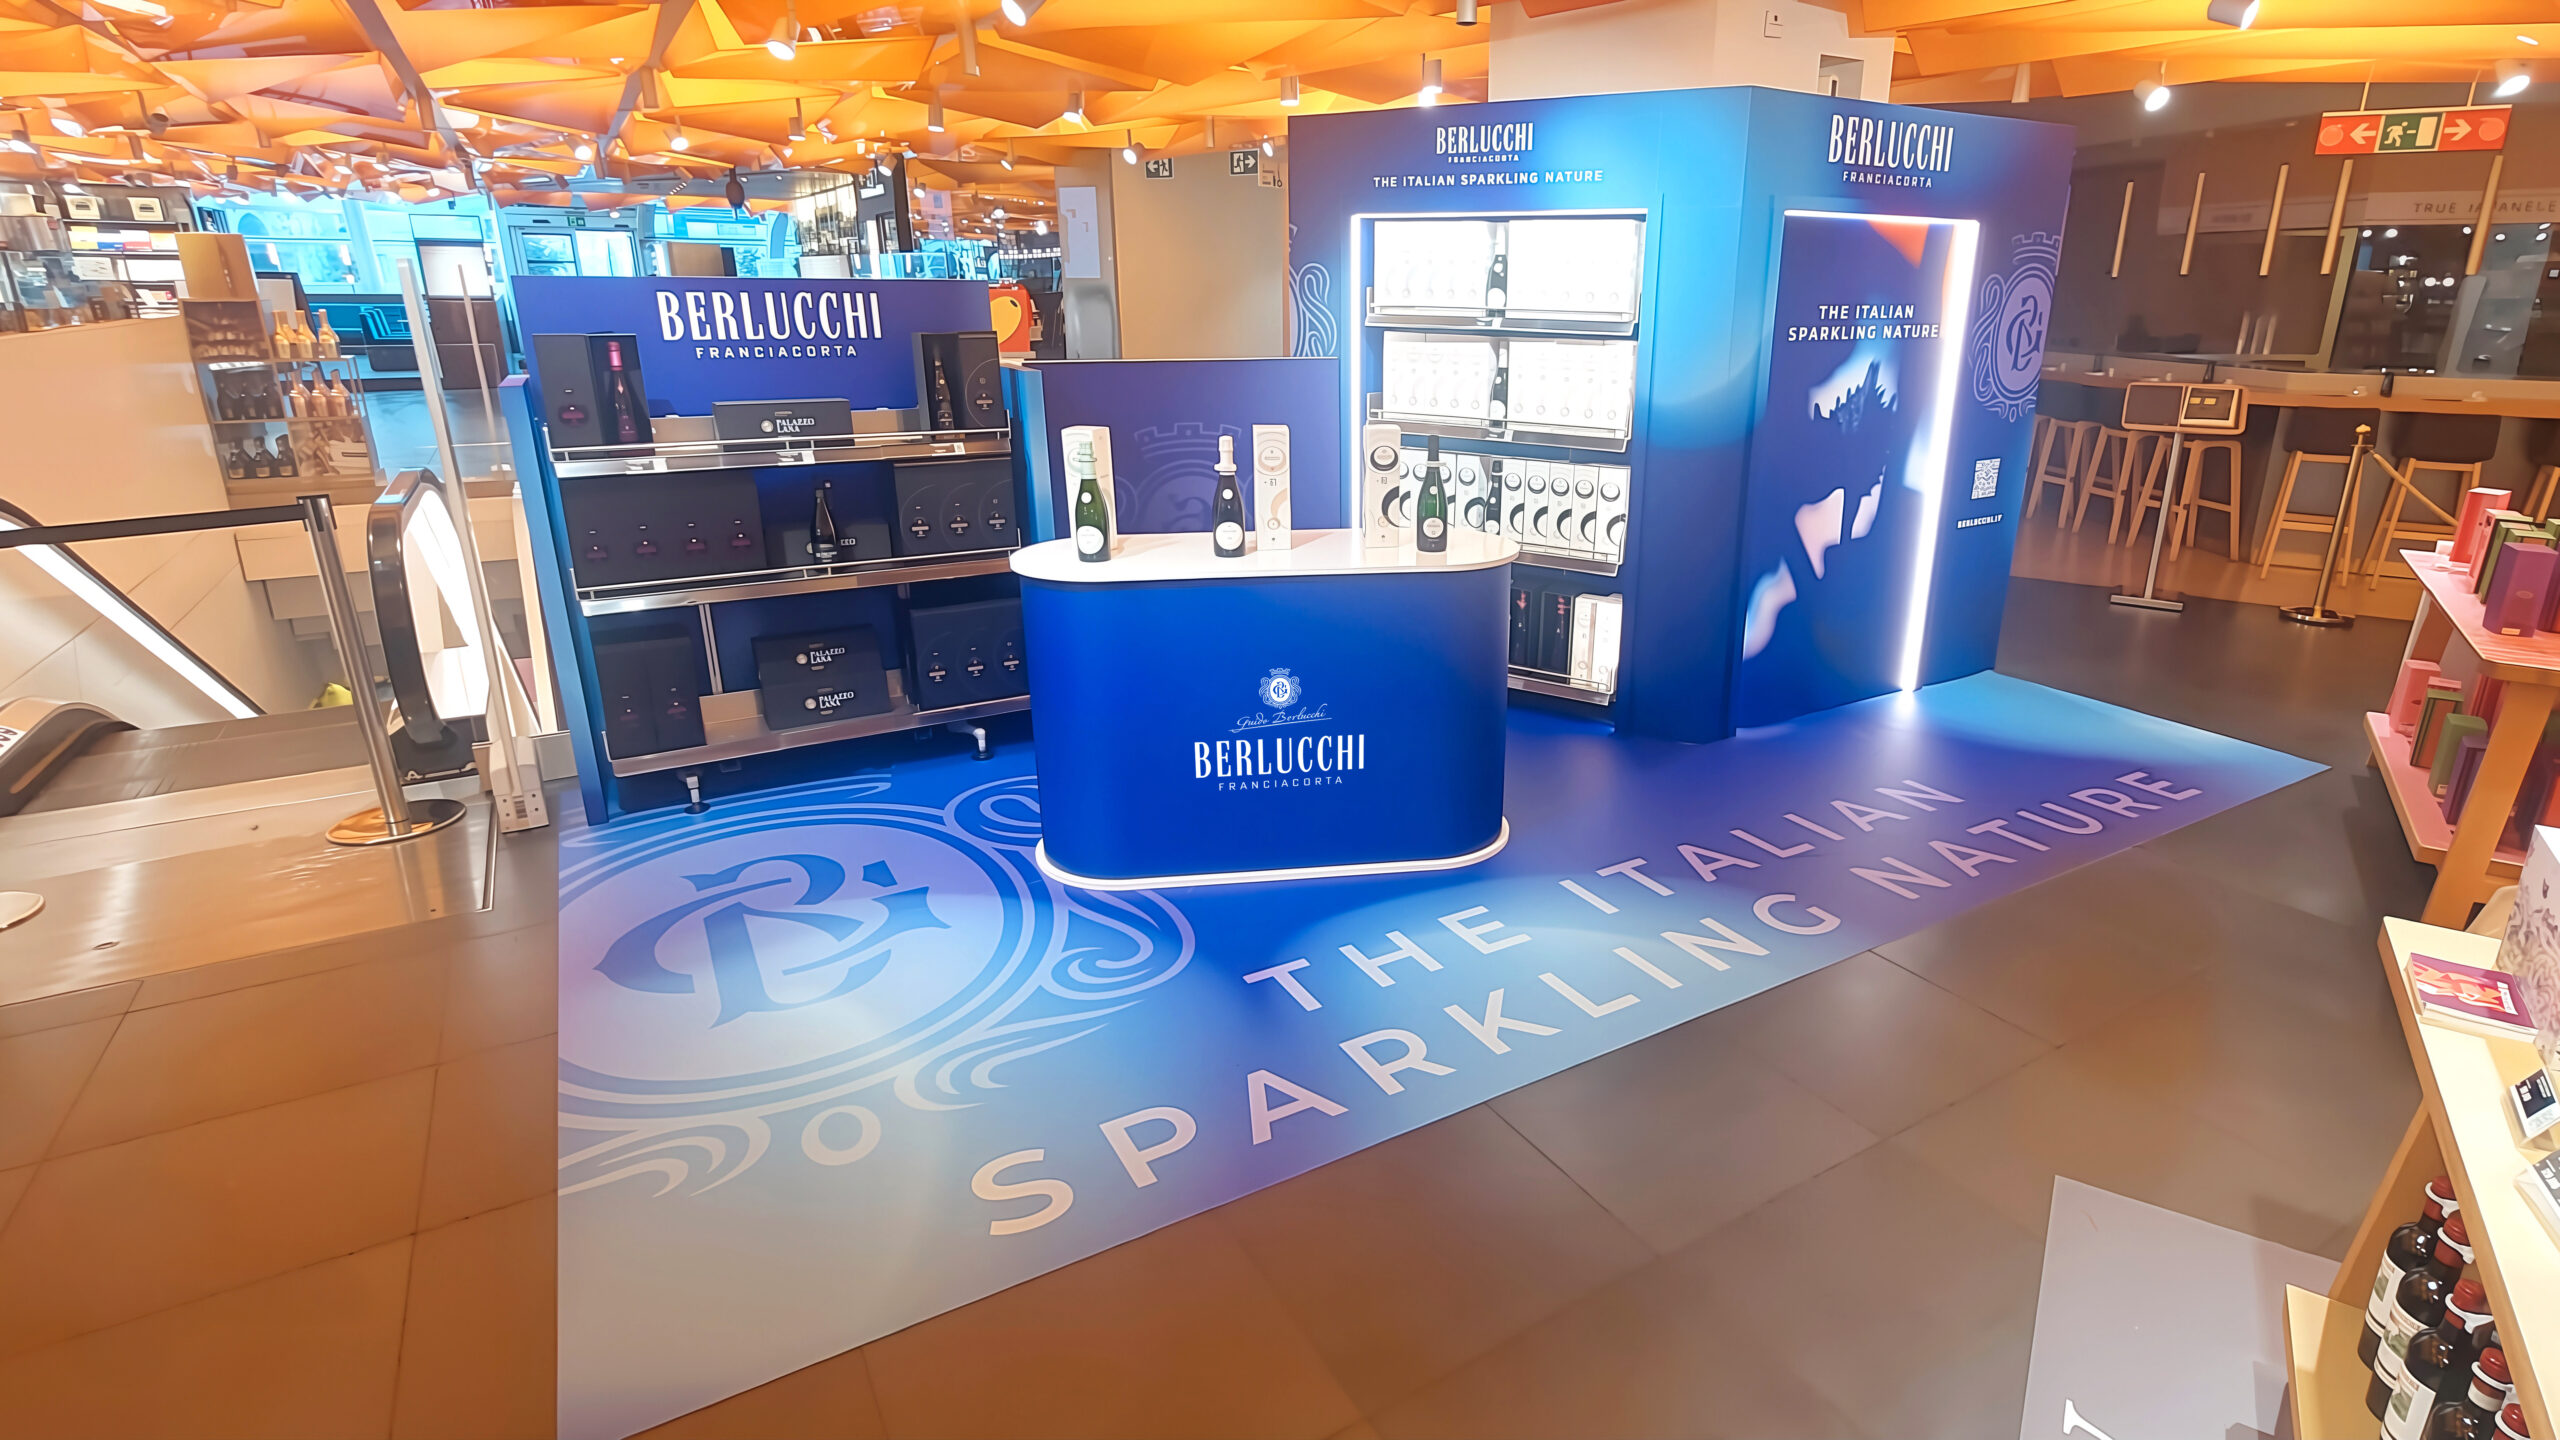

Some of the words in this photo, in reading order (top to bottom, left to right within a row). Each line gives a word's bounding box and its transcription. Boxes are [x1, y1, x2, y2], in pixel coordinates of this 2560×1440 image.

[1436, 122, 1534, 154] BERLUCCHI
[1828, 114, 1954, 173] BERLUCCHI
[1373, 176, 1398, 188] THE
[1403, 175, 1455, 187] ITALIAN
[1460, 172, 1538, 185] SPARKLING
[1545, 170, 1604, 182] NATURE
[1842, 171, 1932, 188] FRANCIACORTA
[2414, 202, 2457, 214] TRUE
[656, 291, 883, 341] BERLUCCHI
[1819, 305, 1850, 320] THE
[1856, 304, 1914, 319] ITALIAN
[1788, 325, 1876, 342] SPARKLING
[1883, 324, 1939, 338] NATURE
[696, 345, 857, 359] FRANCIACORTA
[1272, 703, 1328, 724] Berlucchi
[1194, 734, 1365, 779] BERLUCCHI
[1218, 776, 1343, 791] FRANCIACORTA
[1243, 906, 1532, 1012] THE
[1558, 779, 1966, 915] ITALIAN
[970, 893, 1842, 1236] SPARKLING
[1849, 771, 2203, 900] NATURE
